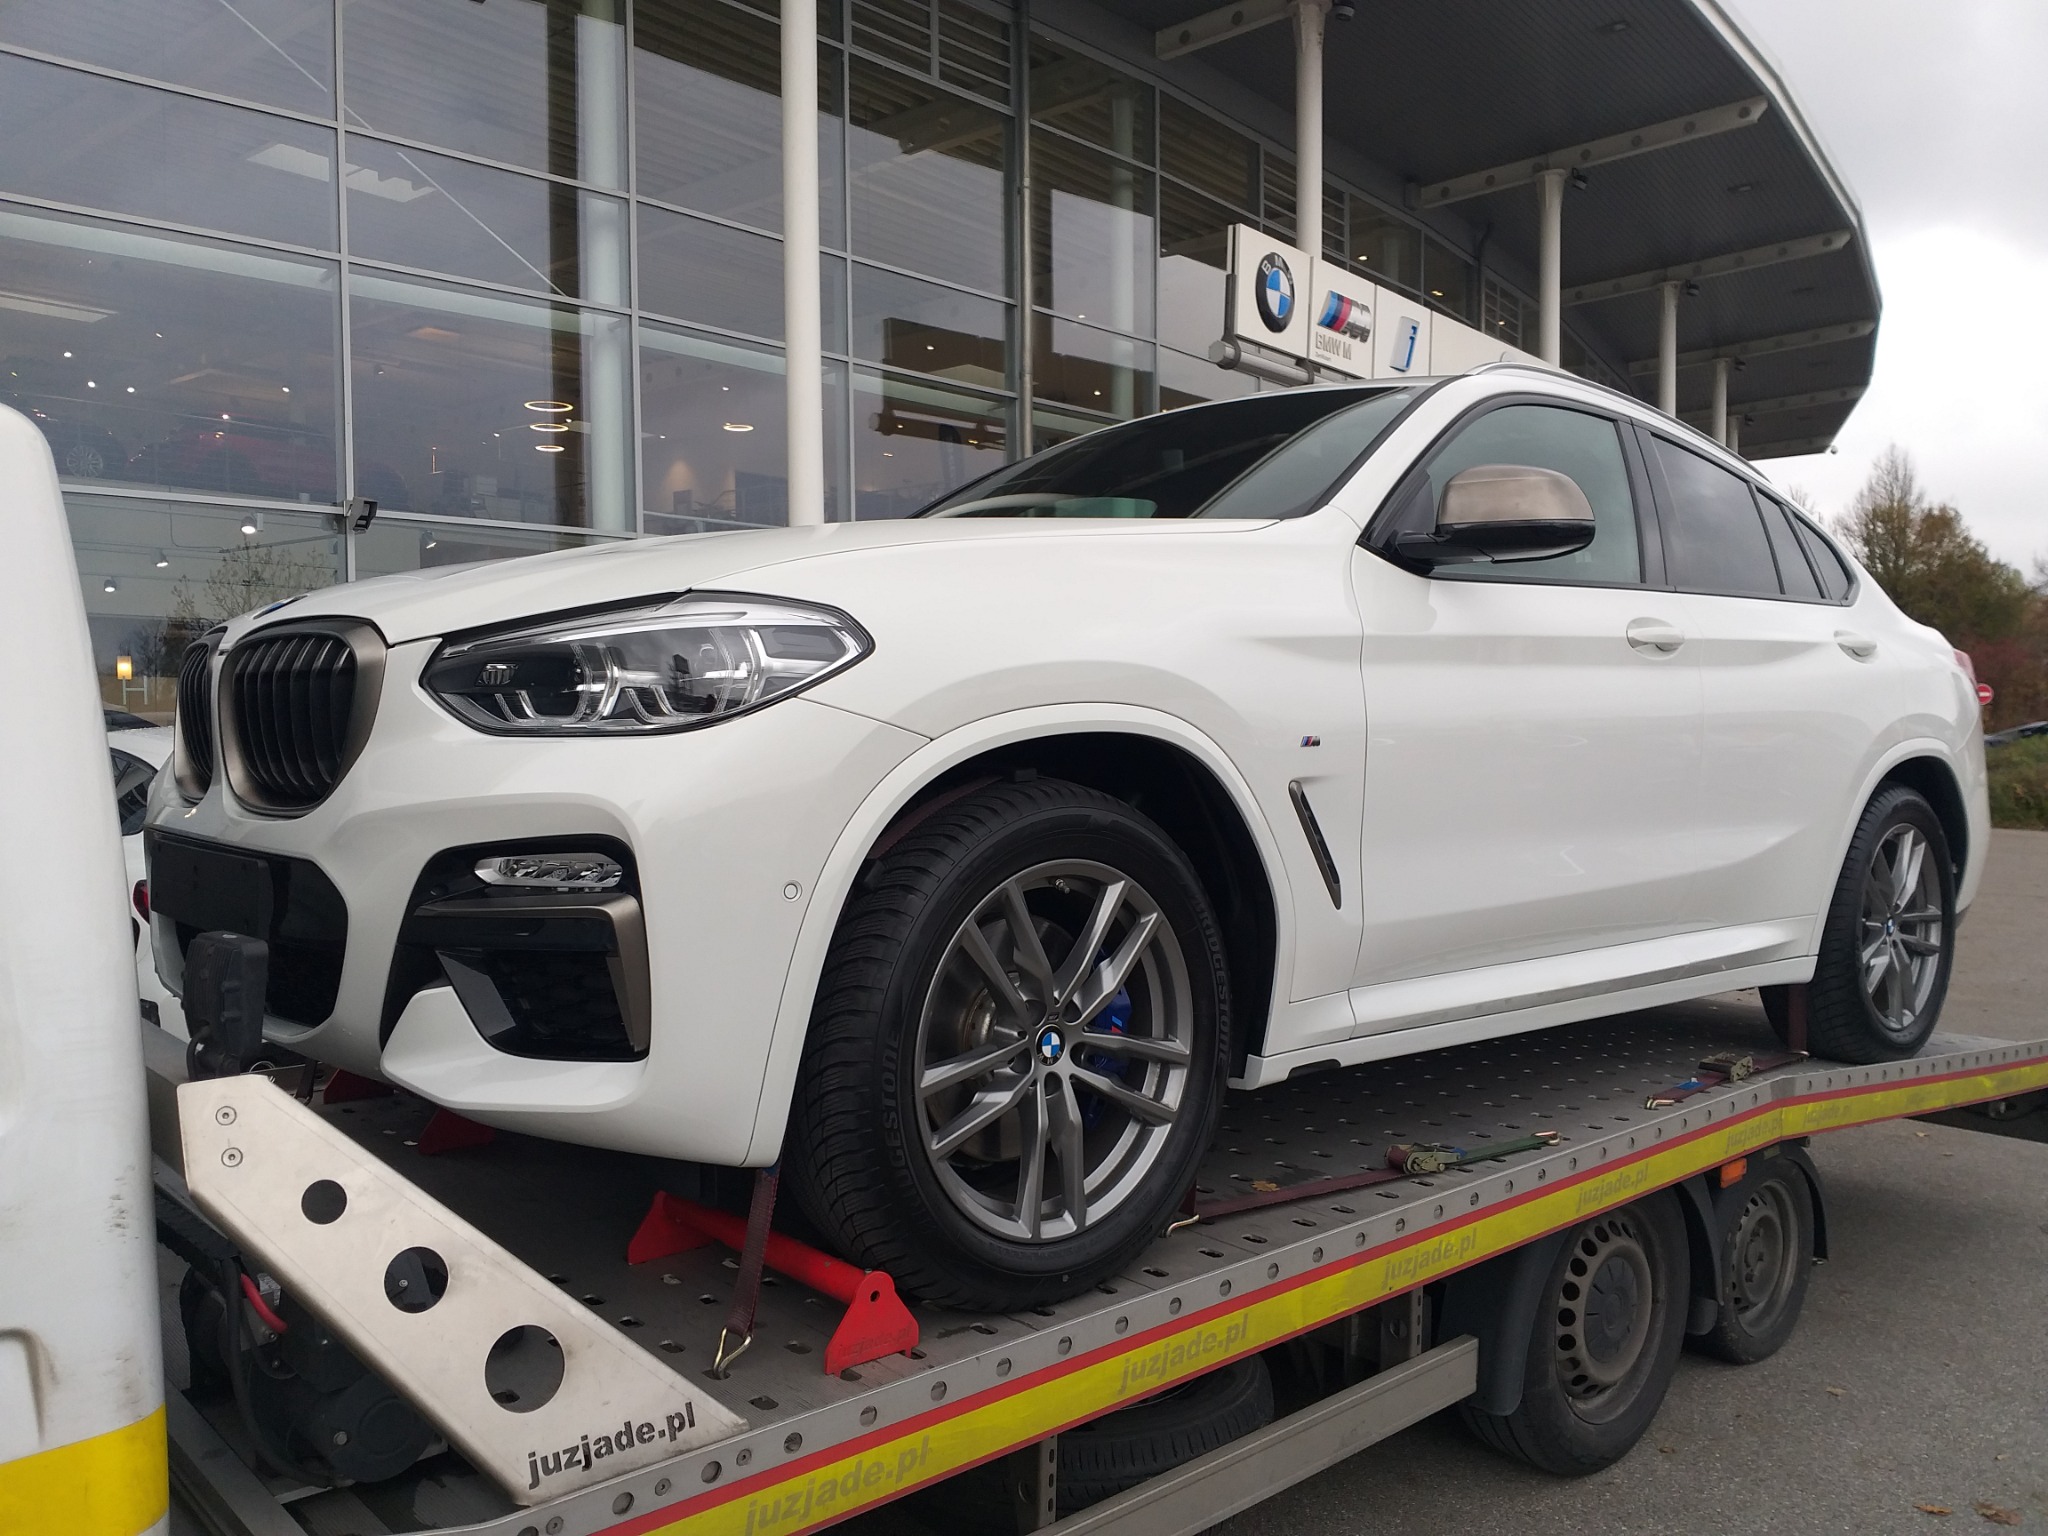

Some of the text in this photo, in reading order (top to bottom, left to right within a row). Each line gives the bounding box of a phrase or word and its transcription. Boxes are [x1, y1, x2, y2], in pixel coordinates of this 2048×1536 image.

[1261, 254, 1293, 285] BMW
[1315, 331, 1342, 356] BMW
[1342, 341, 1352, 360] M
[1575, 1163, 1650, 1212] juzjade.pl
[1381, 1228, 1477, 1289] juzjade.pl
[1117, 1313, 1248, 1395] juzjade.pl
[528, 1401, 696, 1490] juzjade.pl
[744, 1435, 930, 1536] juzjade.pl
